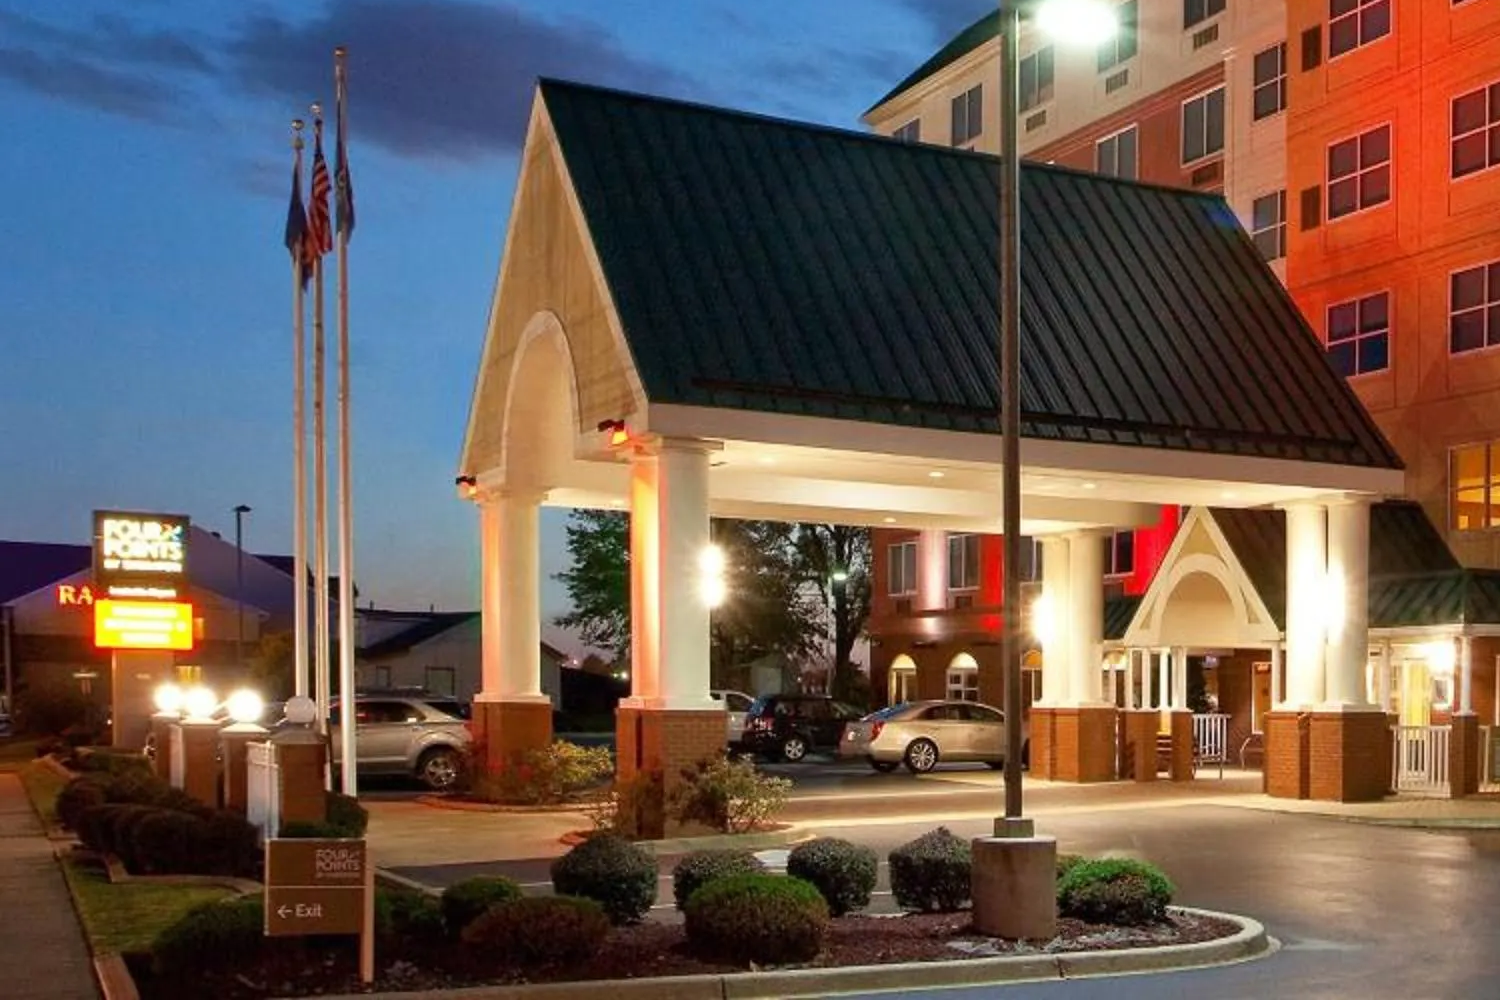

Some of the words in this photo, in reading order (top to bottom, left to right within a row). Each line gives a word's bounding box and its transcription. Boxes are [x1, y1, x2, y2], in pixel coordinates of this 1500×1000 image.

[103, 519, 161, 539] FOUR
[103, 539, 183, 561] POINTS
[295, 903, 322, 917] Exit
